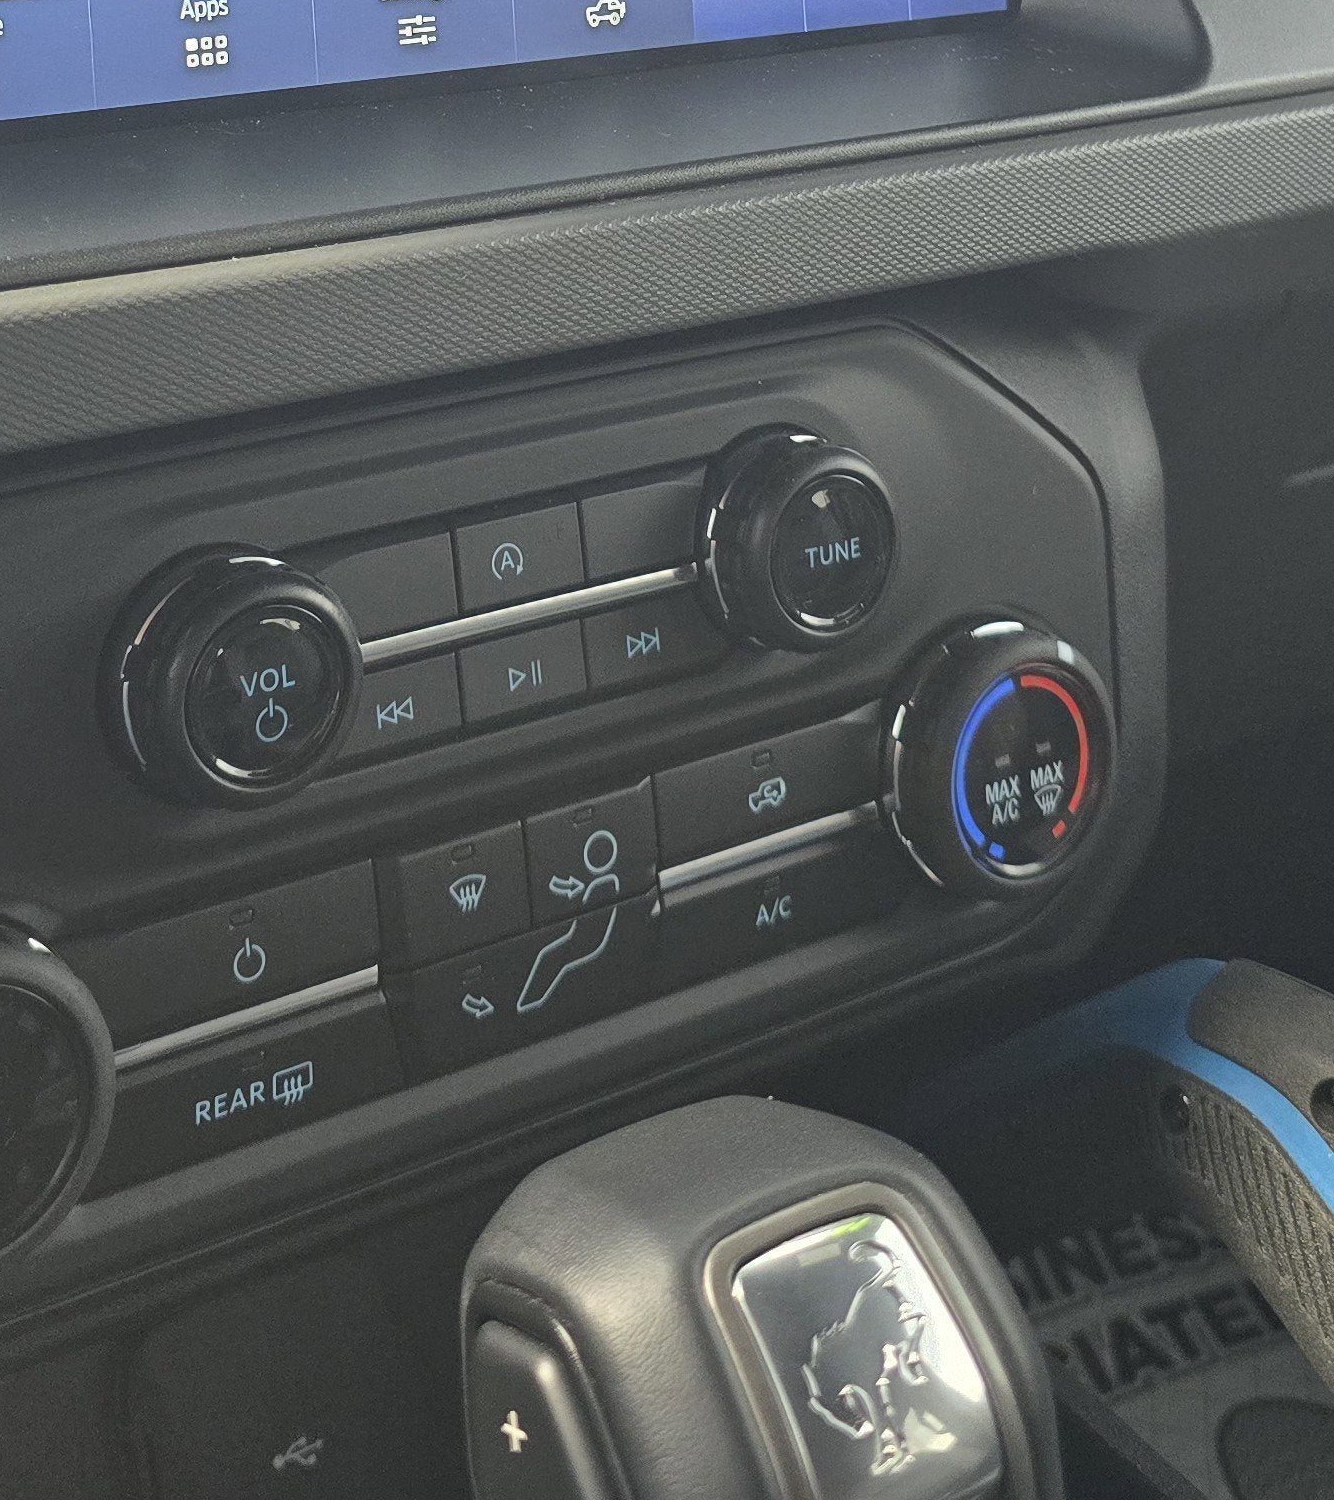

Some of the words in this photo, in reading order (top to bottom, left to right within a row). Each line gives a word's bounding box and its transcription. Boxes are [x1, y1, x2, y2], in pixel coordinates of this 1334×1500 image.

[804, 536, 862, 569] TUNE
[240, 663, 296, 698] VOL
[985, 774, 1021, 806] MAX
[1029, 760, 1065, 791] MAX
[991, 799, 1021, 826] A/C
[755, 895, 792, 927] A/C
[195, 1081, 267, 1126] REAR
